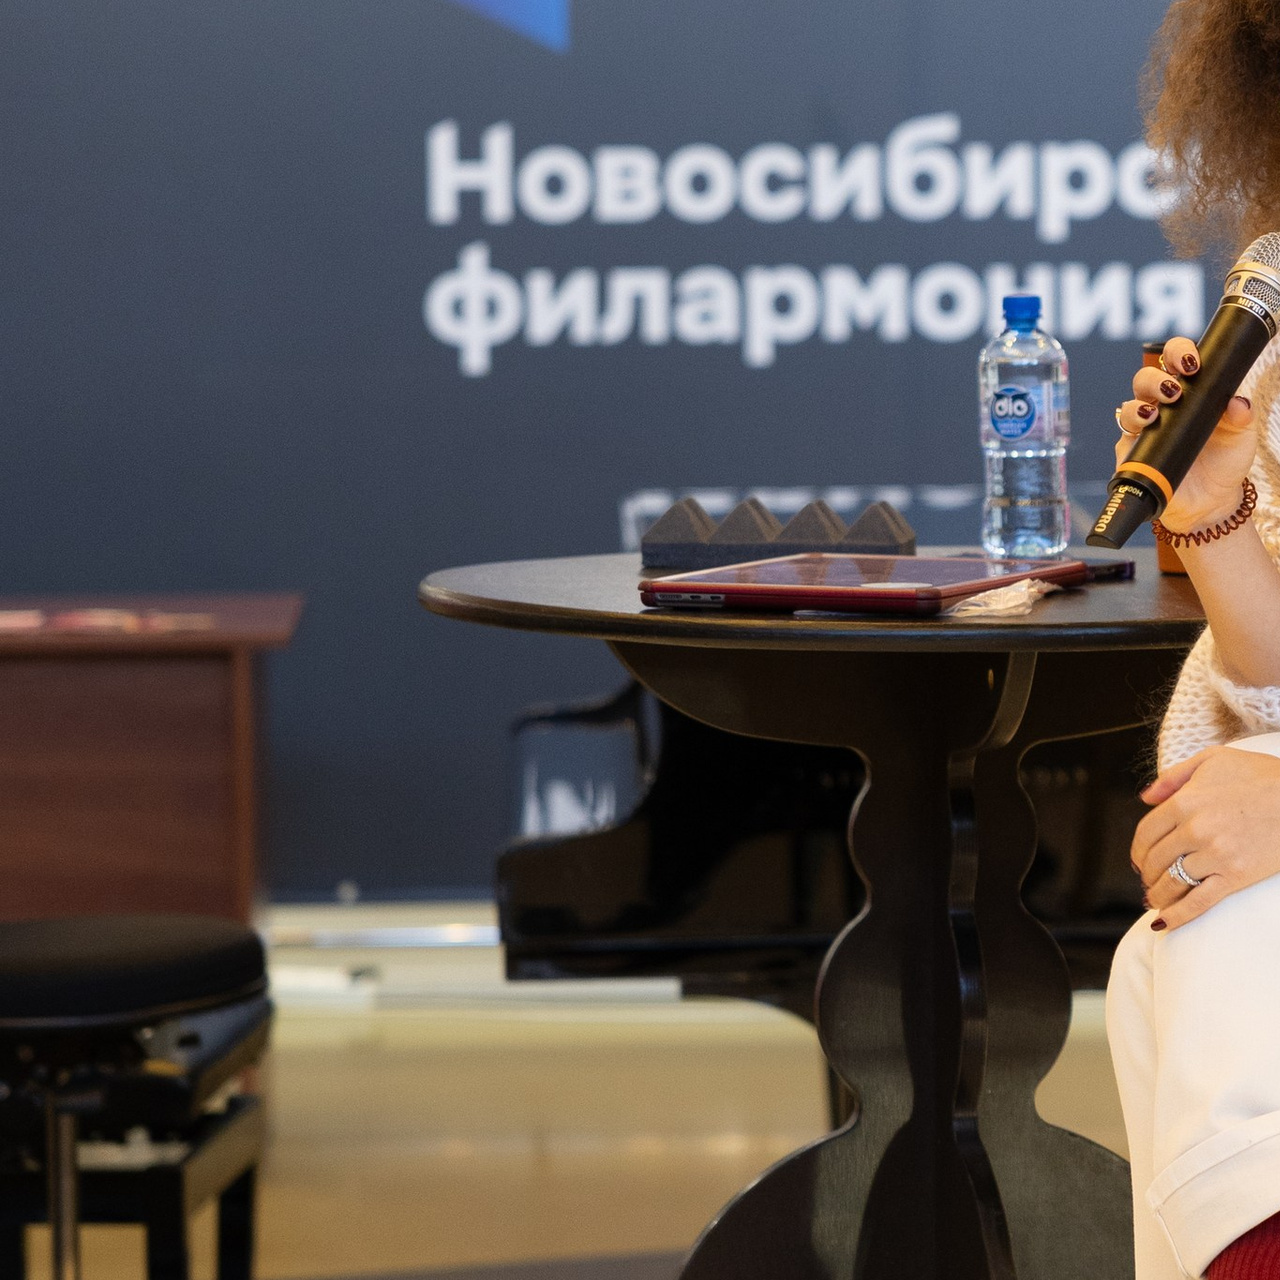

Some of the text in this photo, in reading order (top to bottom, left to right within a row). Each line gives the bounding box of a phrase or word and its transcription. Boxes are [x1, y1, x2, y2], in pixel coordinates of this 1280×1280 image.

[424, 114, 1200, 243] Новосибирс
[422, 240, 1205, 377] филармония
[1236, 297, 1266, 317] MIPRO
[994, 395, 1029, 417] dio
[1094, 492, 1125, 533] MIPRO
